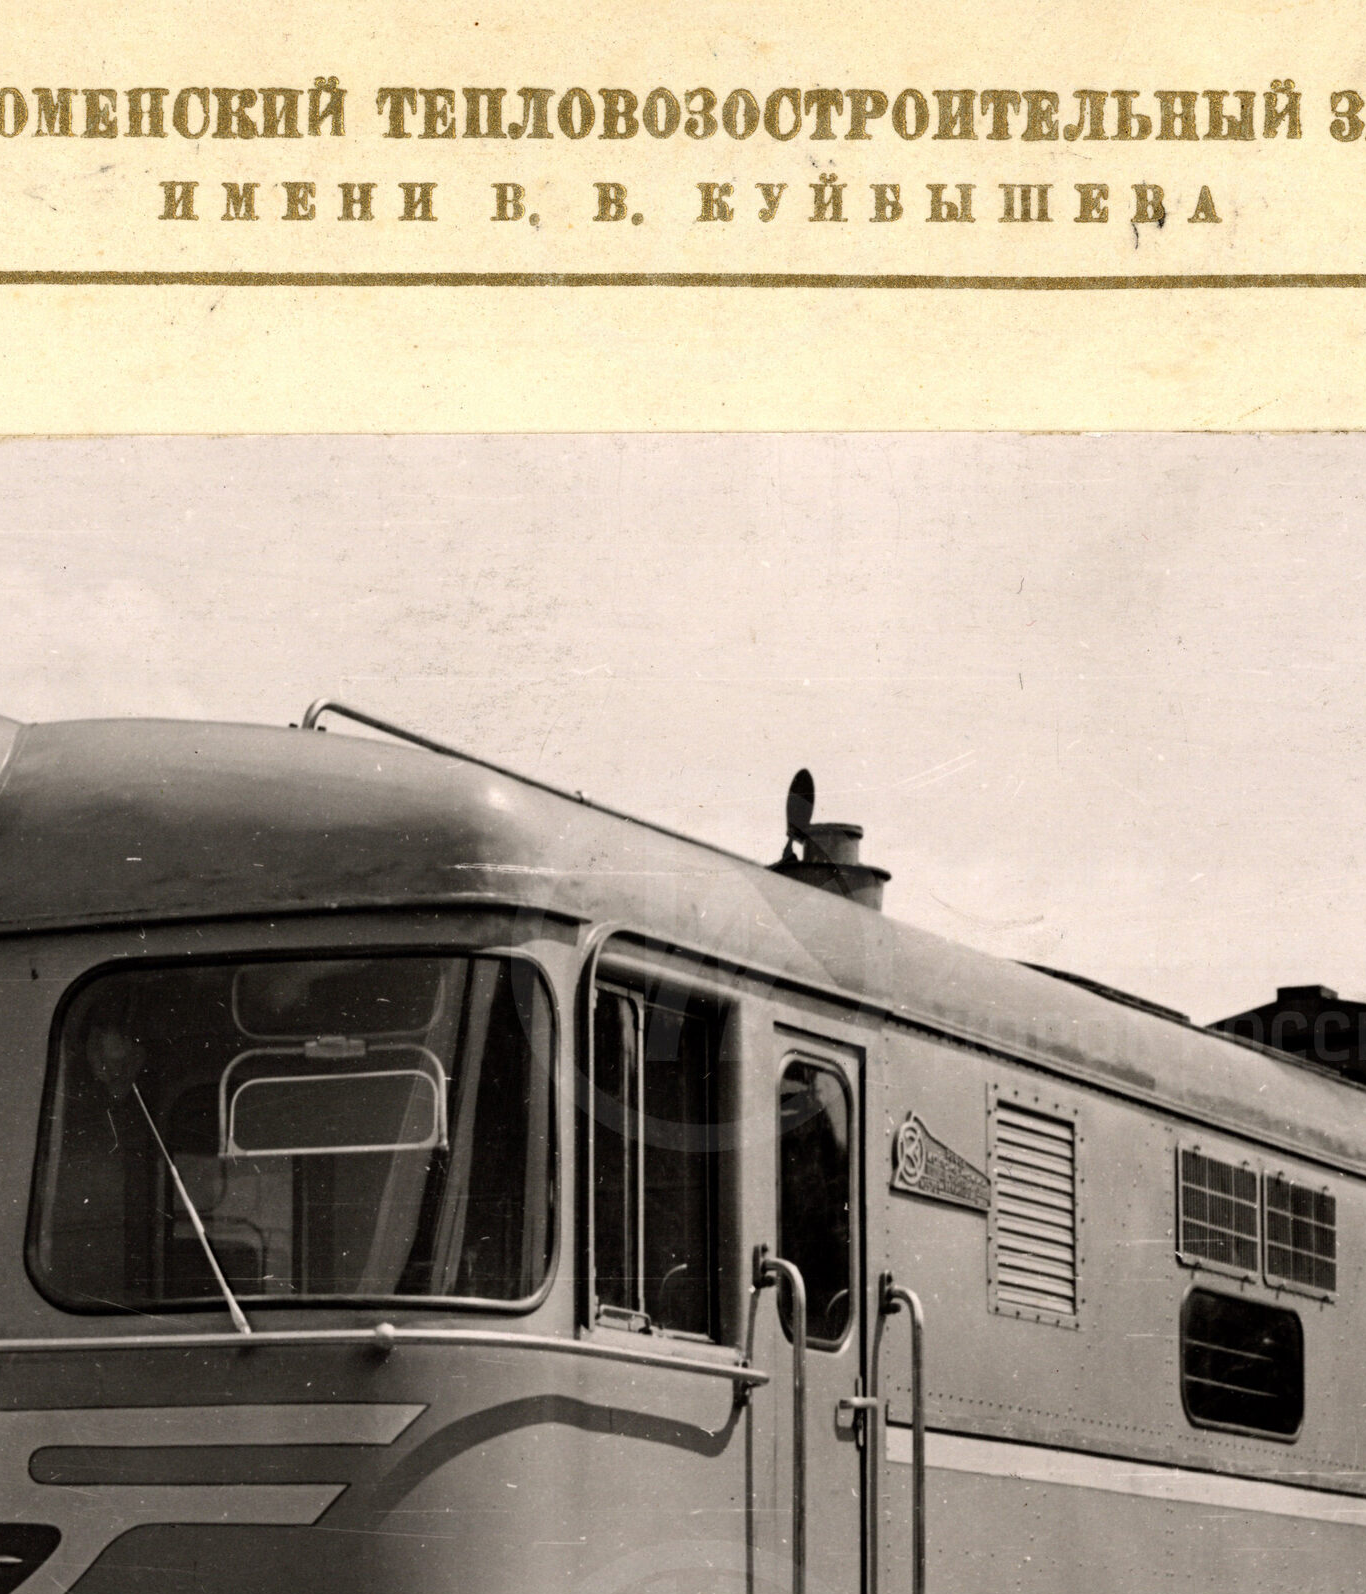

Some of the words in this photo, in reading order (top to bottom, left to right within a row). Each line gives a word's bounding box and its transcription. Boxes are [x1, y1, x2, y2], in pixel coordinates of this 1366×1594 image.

[373, 77, 1304, 143] ТЕПЛОВОЗОСТРОИТЕЛЬНЫЙ
[159, 181, 439, 222] ИМЕНИ
[491, 182, 541, 227] В.
[593, 182, 644, 227] В.
[696, 173, 1223, 225] КУЙБЫШЕВА
